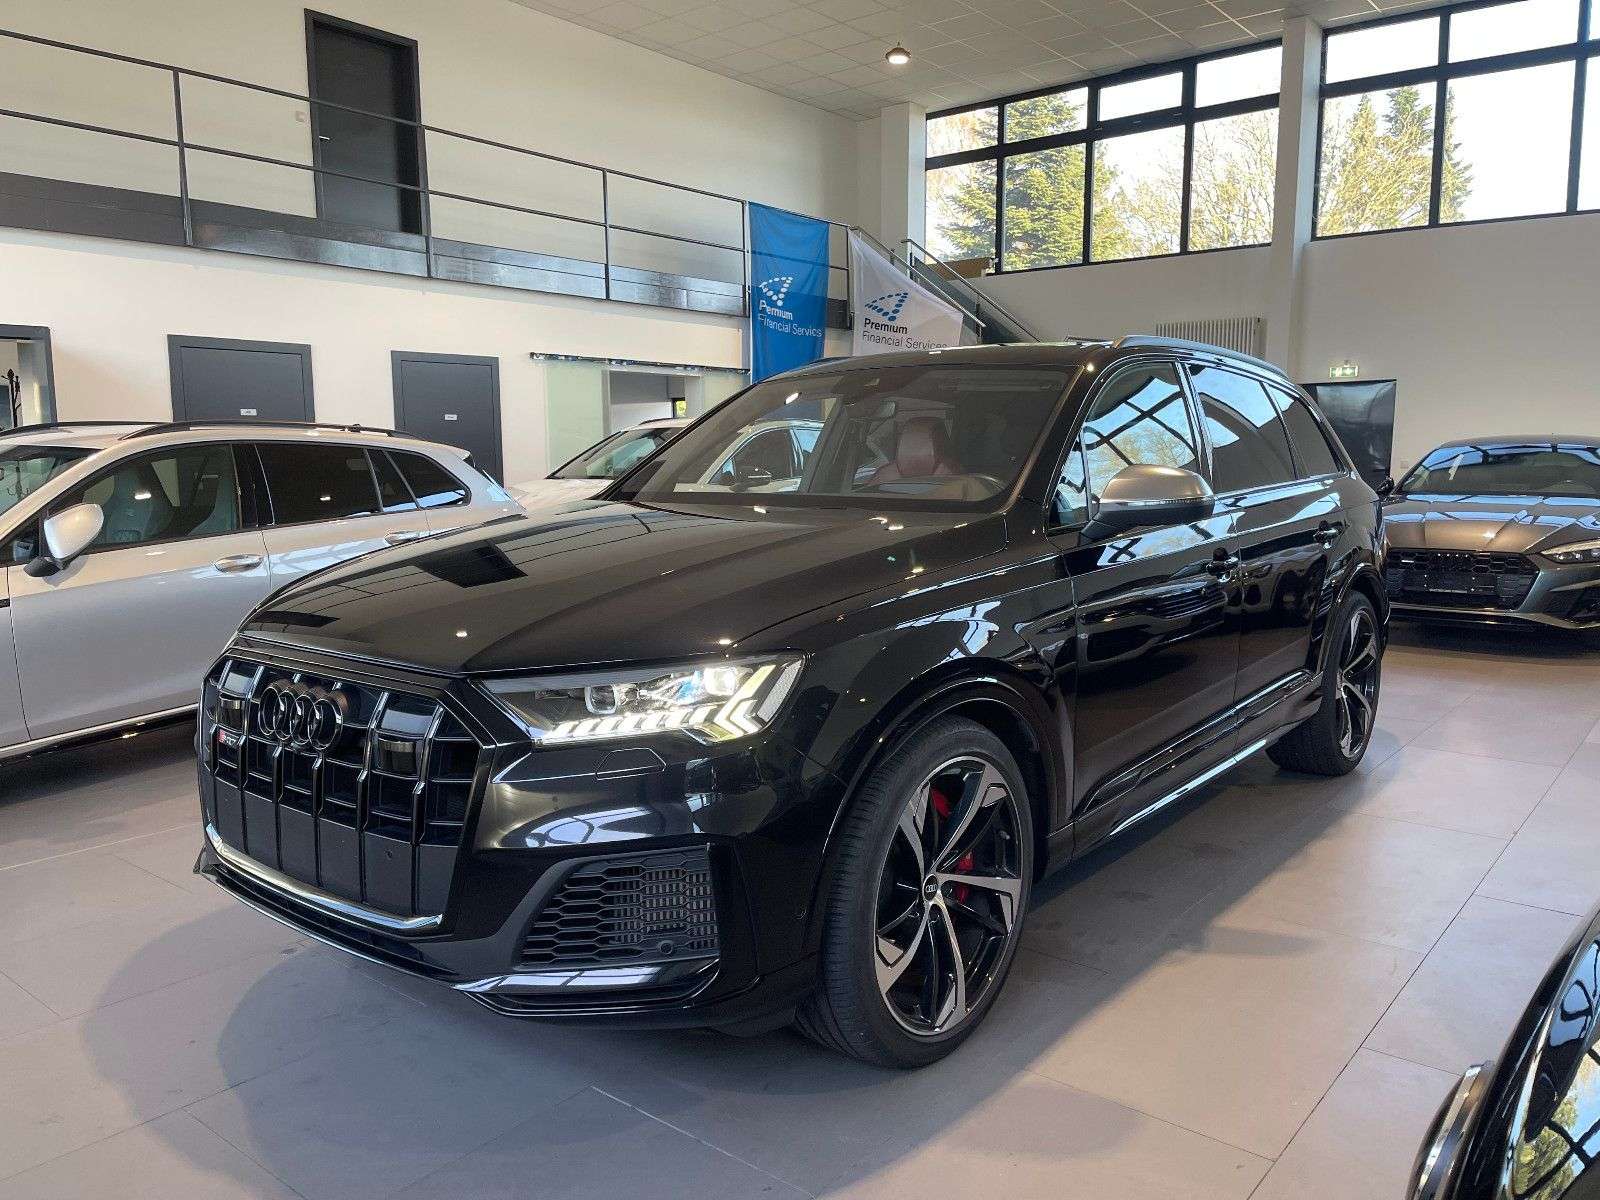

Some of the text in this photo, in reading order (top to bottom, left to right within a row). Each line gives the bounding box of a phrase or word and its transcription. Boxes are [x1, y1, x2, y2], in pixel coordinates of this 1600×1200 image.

[759, 299, 793, 321] Pemium
[863, 317, 908, 335] Premium
[862, 330, 903, 347] Financial
